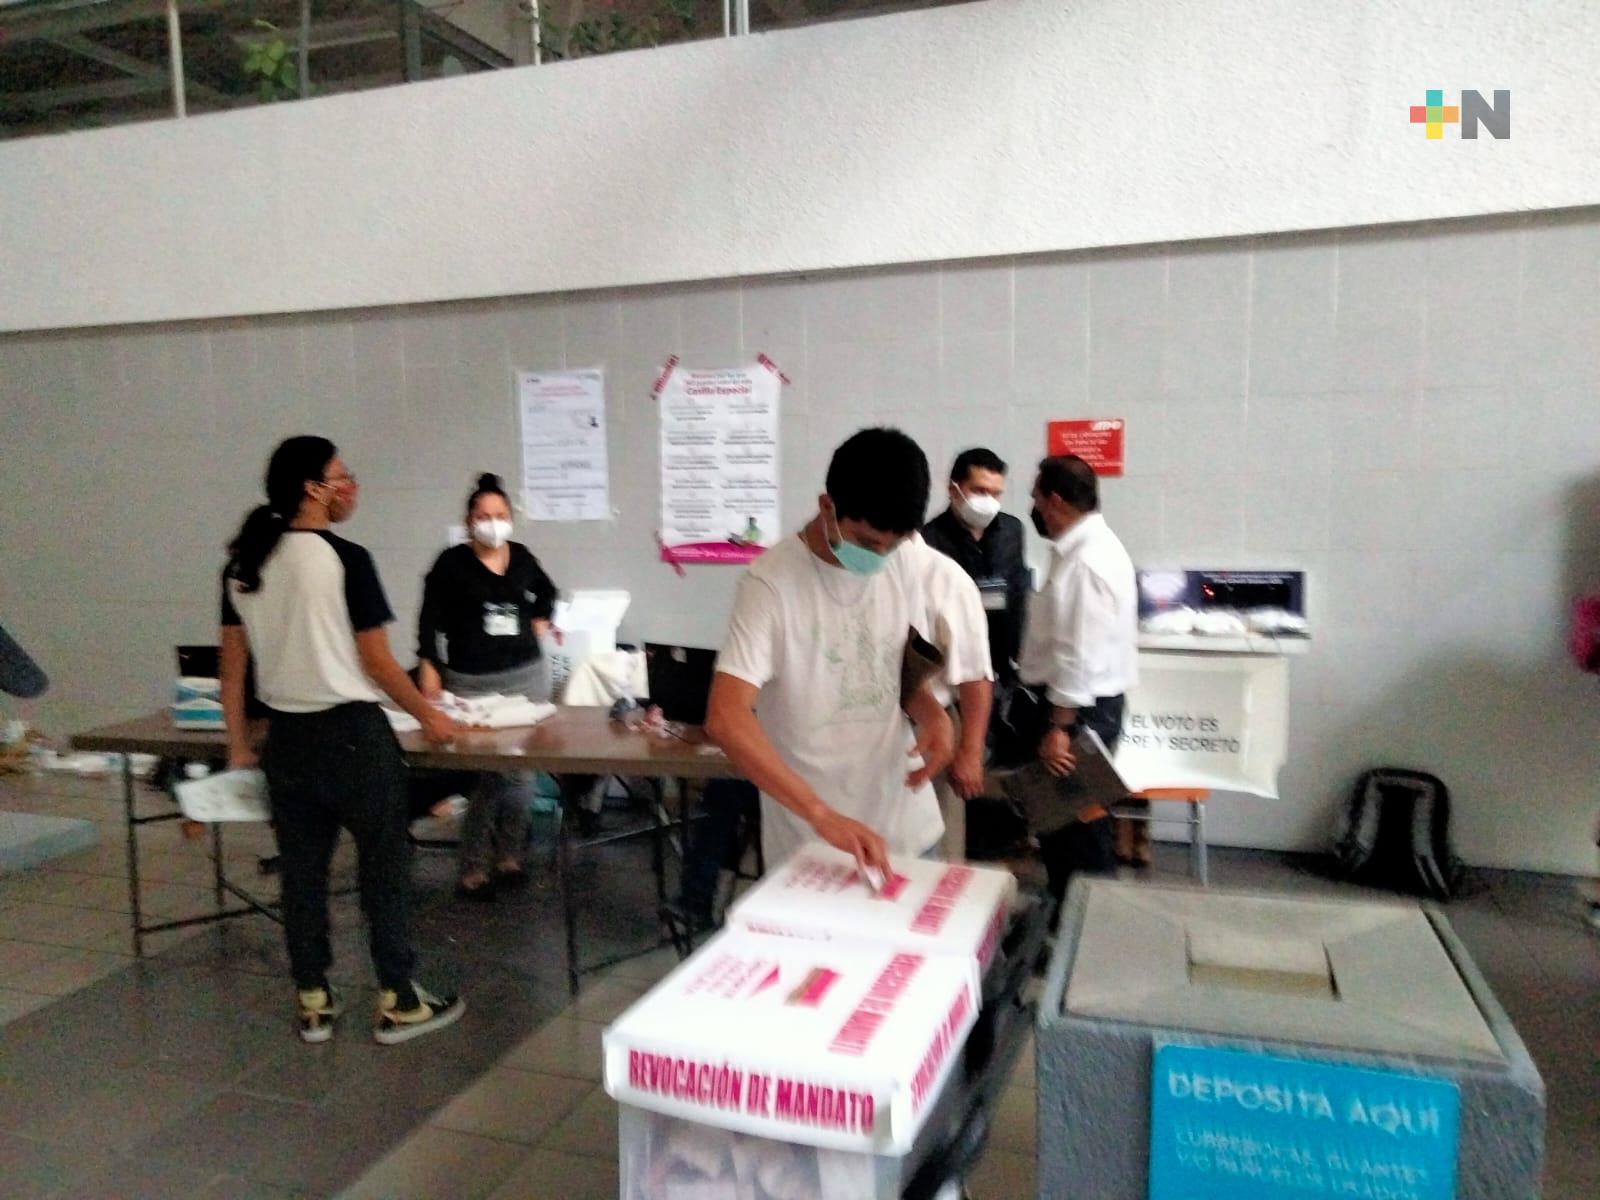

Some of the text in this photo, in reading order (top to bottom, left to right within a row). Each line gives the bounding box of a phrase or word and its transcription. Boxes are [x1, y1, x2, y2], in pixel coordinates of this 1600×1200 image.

[1131, 714, 1219, 732] EL VOTO ES
[1168, 736, 1240, 753] SECRETO
[629, 1050, 874, 1138] REVOCACIÓN DE MANDATO
[1168, 1068, 1336, 1121] DEPOSITA
